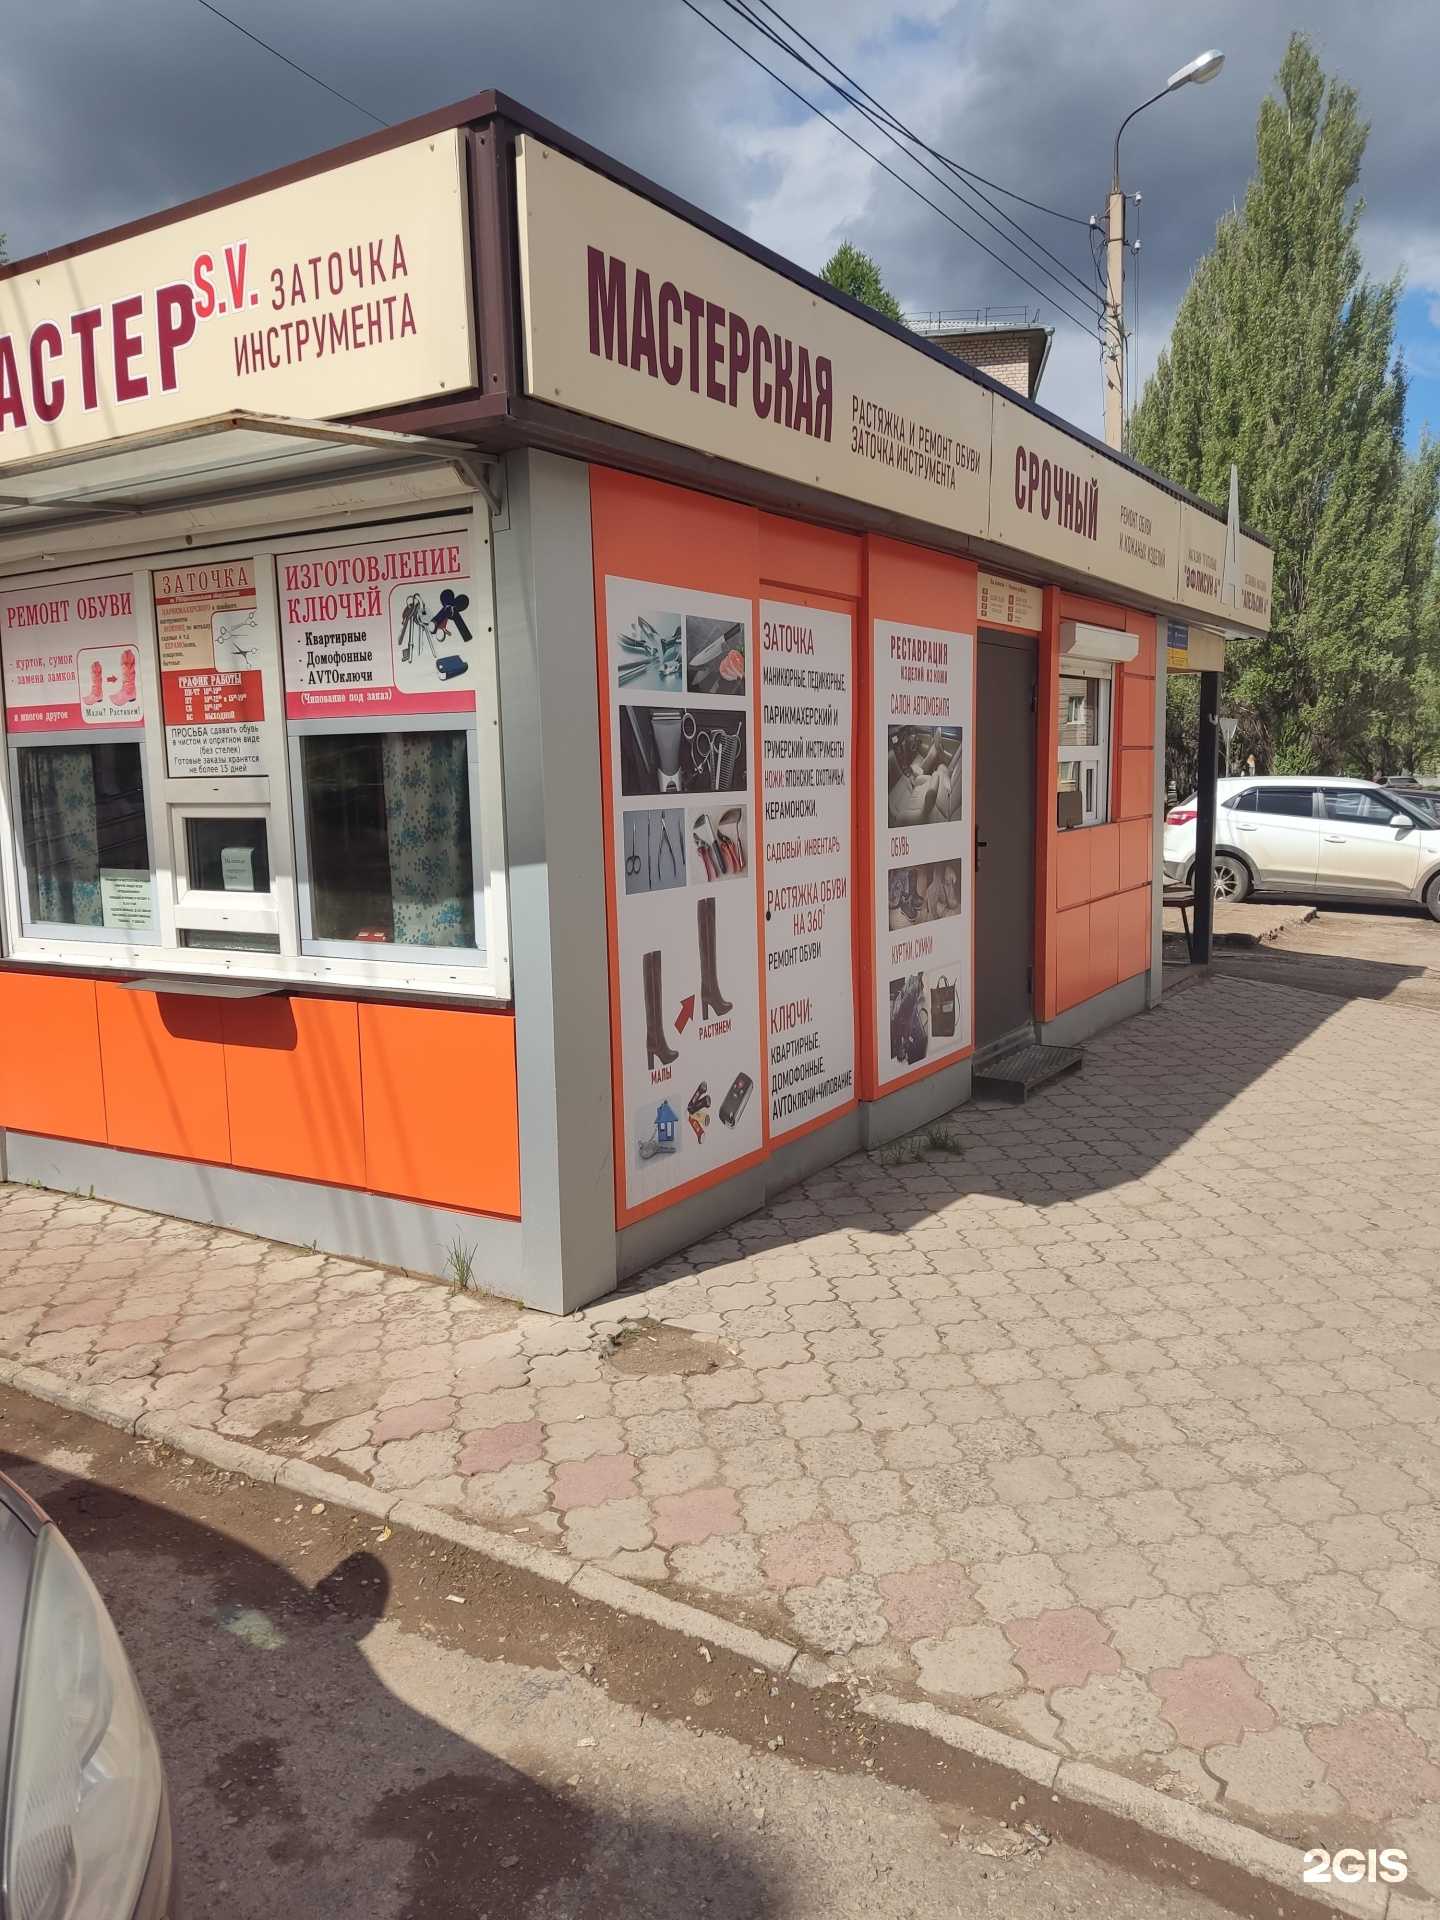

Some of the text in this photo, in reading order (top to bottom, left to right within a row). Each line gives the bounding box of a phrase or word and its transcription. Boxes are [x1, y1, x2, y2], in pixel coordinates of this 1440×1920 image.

[193, 243, 258, 317] S.V.
[271, 234, 408, 311] ЗАТОЧКА
[233, 292, 417, 377] ИНСТРУМЕНТА
[587, 245, 833, 443] МАСТЕРСКАЯ
[852, 394, 981, 474] РАСТЯЖКА И РЕМОНТ ОБУВИ
[851, 425, 956, 490] ЗАТОЧКА ИНСТРУМЕНТА
[1014, 445, 1099, 541] СРОЧНЫЙ
[162, 567, 248, 594] ЗАТОЧКА
[285, 546, 461, 591] ИЗГОТОВЛЕНИЕ
[7, 600, 70, 629] РЕМОНТ
[77, 592, 132, 620] ОБУВИ
[288, 585, 383, 624] КЛЮЧЕЙ
[305, 631, 367, 648] Квартирные
[763, 622, 815, 655] ЗАТОЧКА
[49, 655, 73, 668] сумок
[306, 650, 373, 668] Домофонные
[890, 635, 948, 667] РЕСТАВРАЦИЯ
[17, 672, 76, 685] замена замков
[179, 673, 241, 688] ГРАФИК РАБОТЫ
[900, 665, 924, 684] ИЗДЕЛИЙ
[926, 670, 933, 683] ИЗ
[349, 691, 363, 703] под
[891, 693, 950, 717] САЛОН АВТОМОБИЛЯ
[764, 704, 839, 726] ПАРИКМАХЕРСКИЙ И
[171, 724, 259, 738] ПРОСЬБА сдавать обувь
[209, 737, 241, 746] опрятном
[174, 757, 201, 765] Готовые
[228, 755, 260, 763] хранятся
[805, 740, 844, 758] ИНСТРУМЕНТЫ
[199, 765, 219, 773] более
[220, 765, 227, 773] 15
[231, 764, 247, 773] дней
[767, 836, 840, 863] САДОВЫЙ ИНВЕНТАРЬ
[890, 836, 909, 857] ОБУВЬ
[768, 877, 846, 911] РАСТЯЖКА ОБУВИ
[793, 912, 805, 936] НА
[769, 941, 821, 970] РЕМОНТ ОБУВИ
[770, 999, 813, 1035] КЛЮЧИ:
[699, 1019, 732, 1040] РАСТЯНЕМ
[651, 1066, 672, 1085] МАЛЫ
